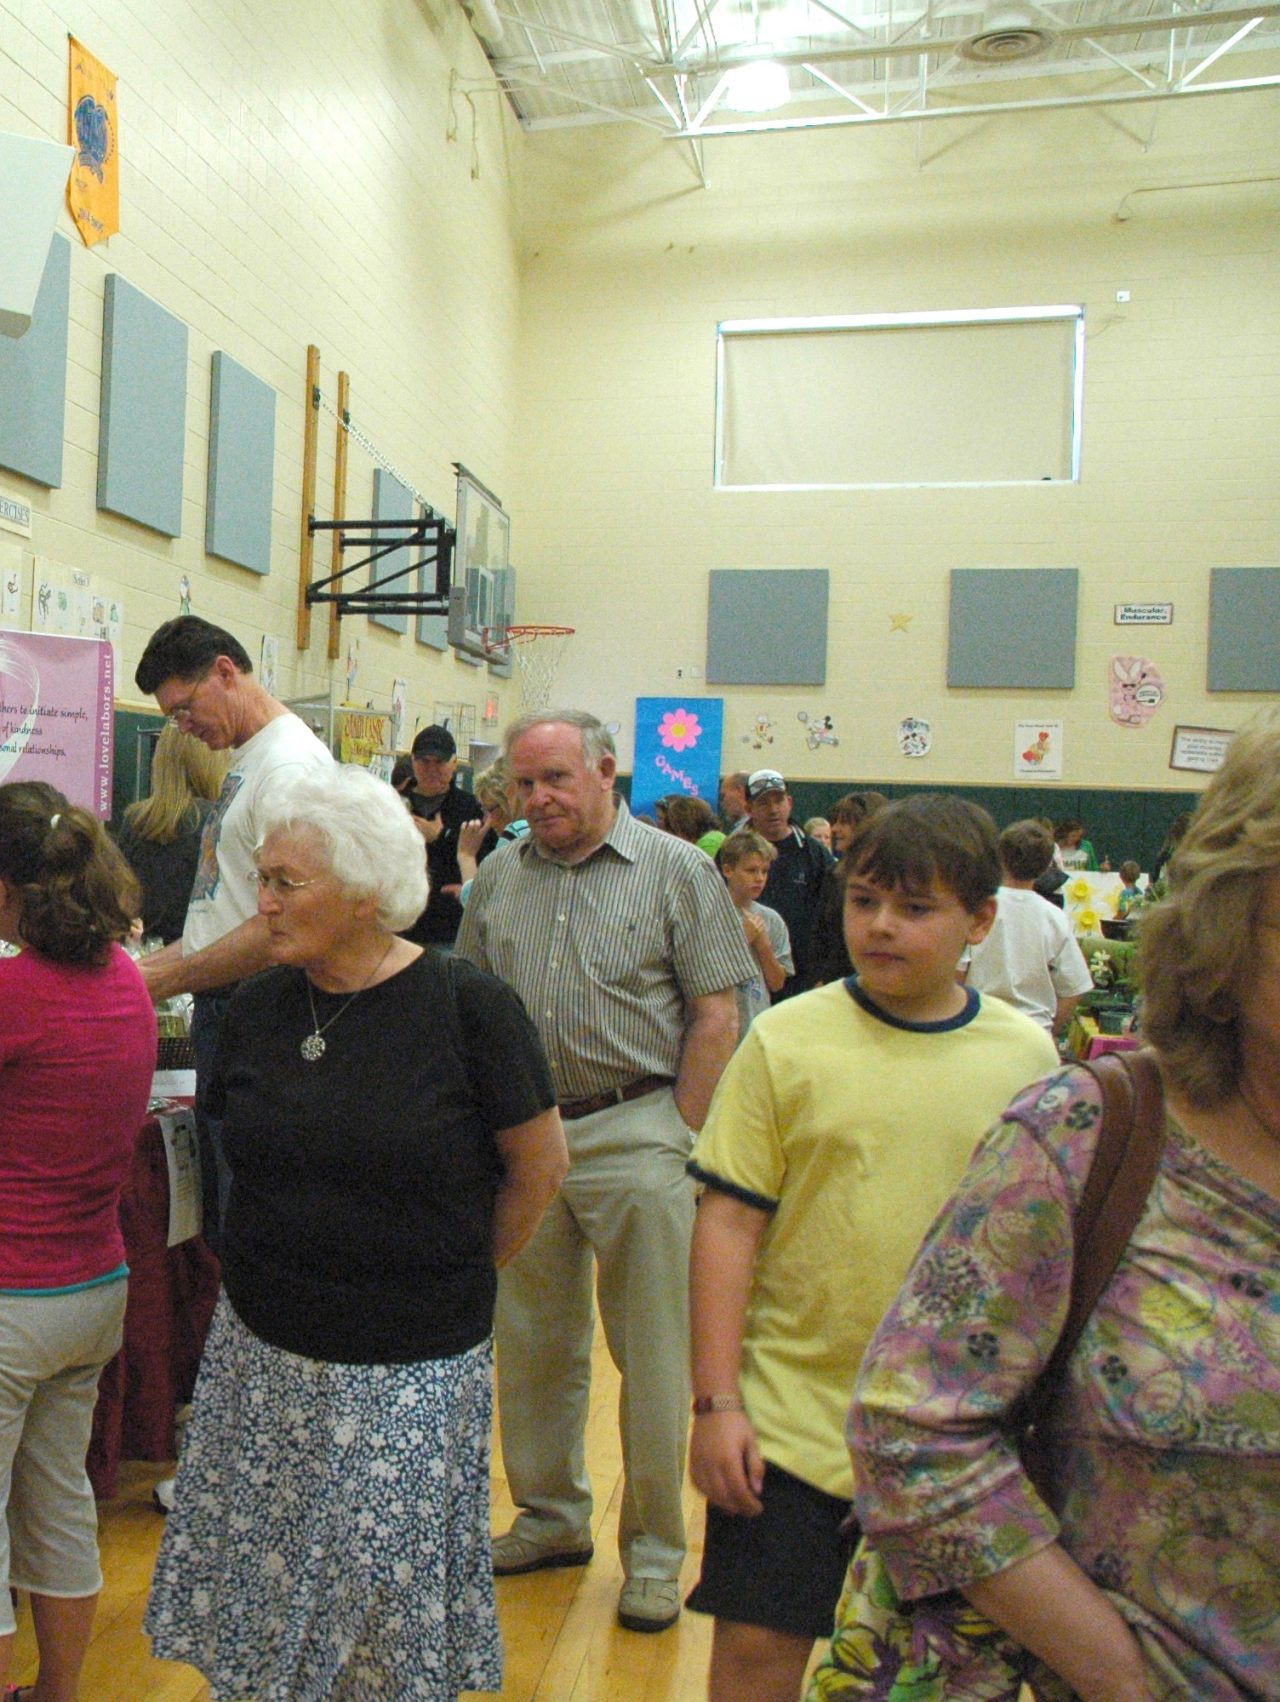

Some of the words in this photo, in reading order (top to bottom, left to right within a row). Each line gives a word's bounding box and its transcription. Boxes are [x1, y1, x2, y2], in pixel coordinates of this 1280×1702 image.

[10, 722, 43, 736] kindness
[98, 653, 112, 812] www.lovelabors.net
[655, 754, 699, 796] GAMES
